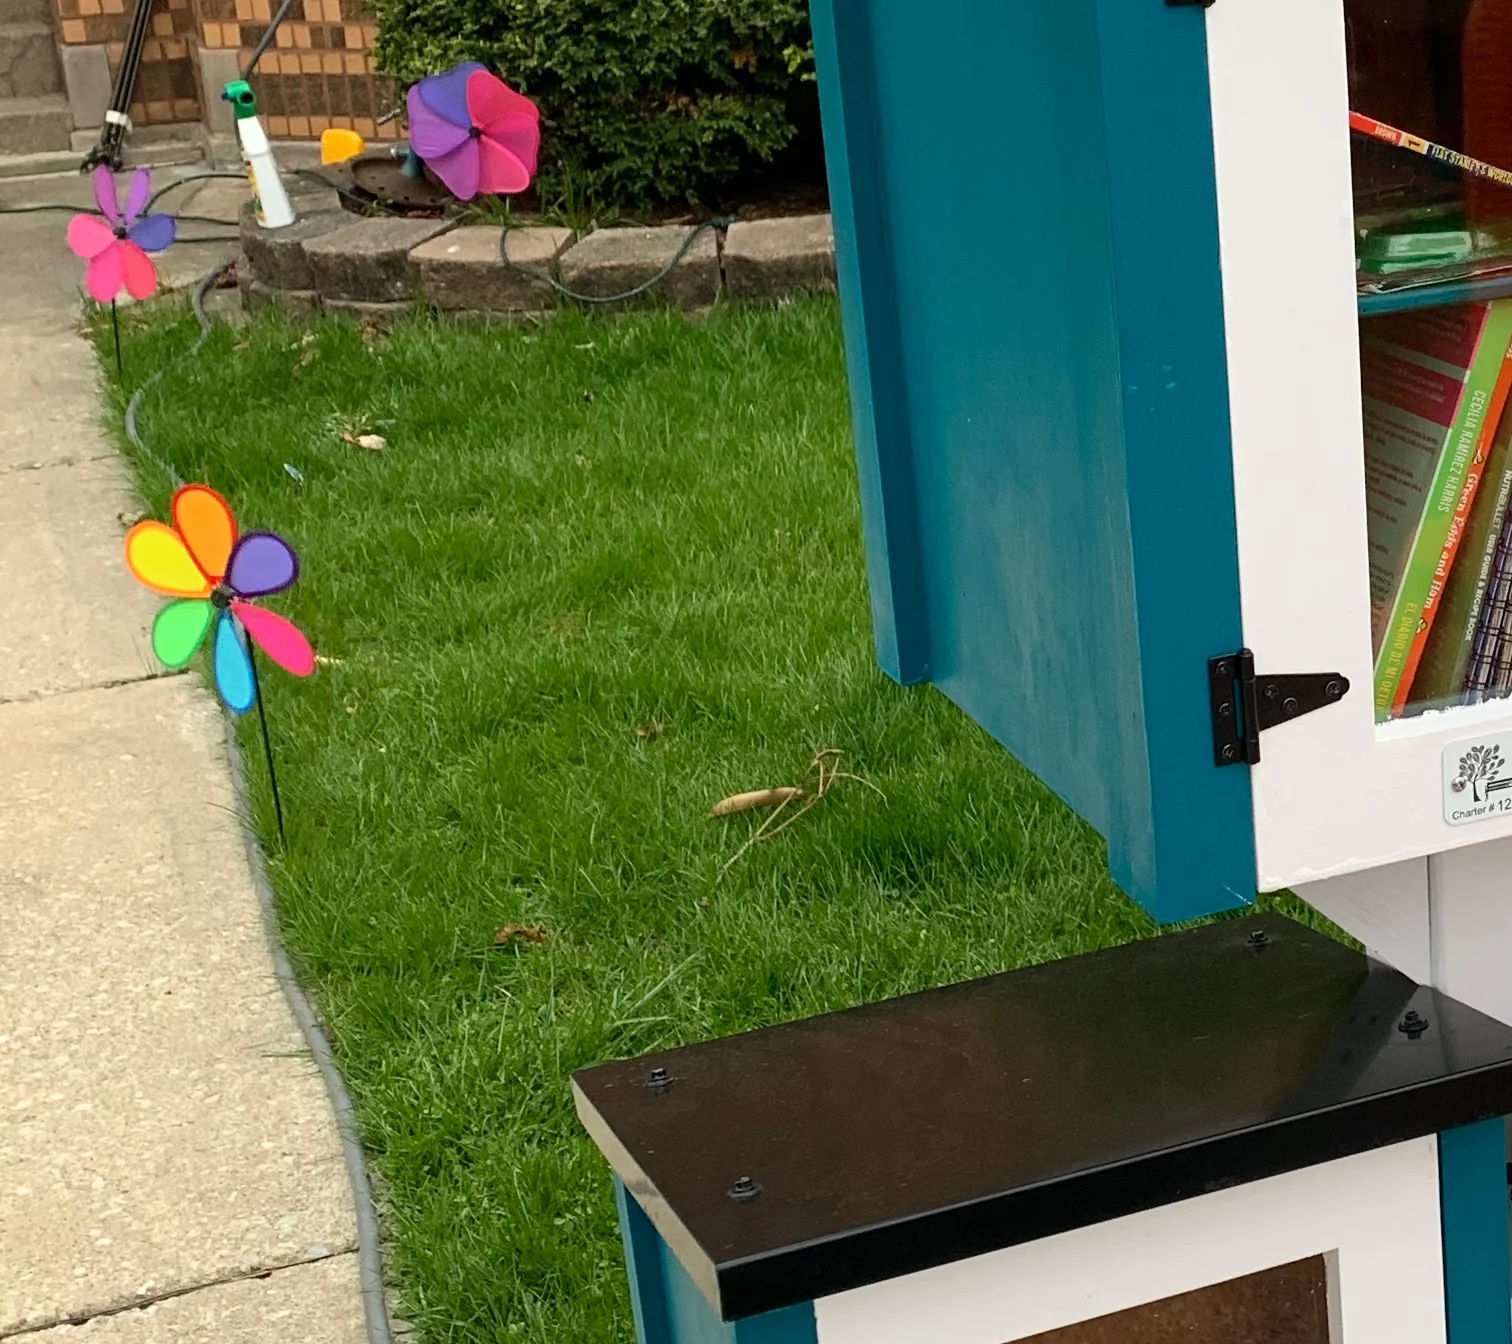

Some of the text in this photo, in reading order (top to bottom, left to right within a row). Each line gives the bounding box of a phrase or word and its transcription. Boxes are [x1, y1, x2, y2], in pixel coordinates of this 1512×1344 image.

[1464, 390, 1487, 429] CECILIA
[1438, 475, 1460, 513] HARRIS
[1457, 473, 1479, 512] Green
[1486, 534, 1497, 554] USER
[1433, 549, 1453, 577] and
[1480, 554, 1492, 581] GUIDE
[1424, 576, 1443, 609] Ham
[1406, 602, 1417, 619] EL
[1398, 617, 1414, 650] DIARIO
[1465, 618, 1476, 642] BOOK
[1389, 648, 1402, 664] DE
[1385, 664, 1397, 683] MI
[1451, 803, 1488, 821] Charter
